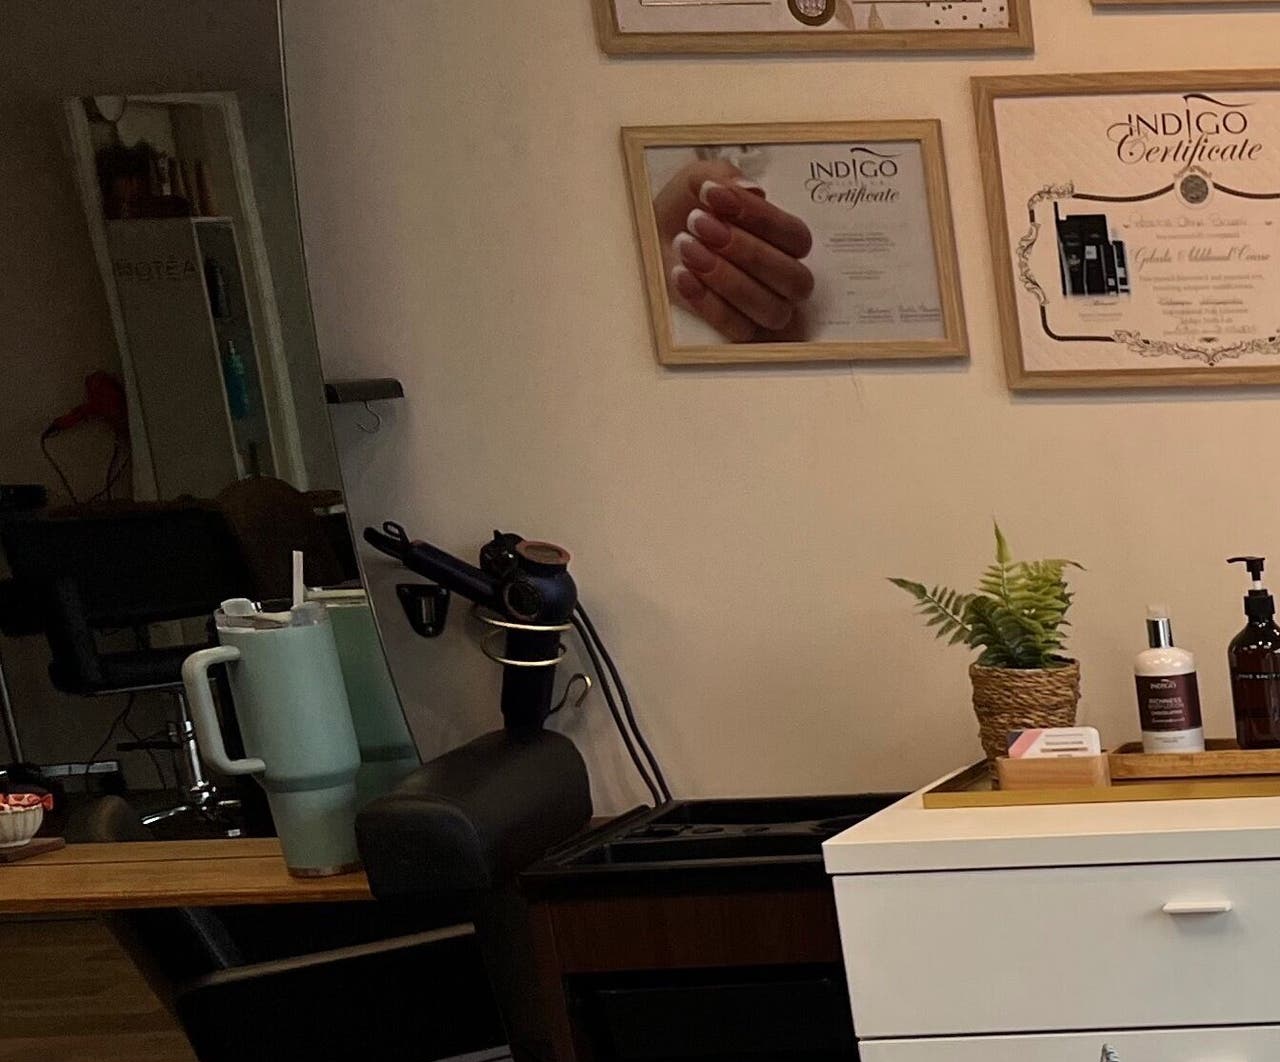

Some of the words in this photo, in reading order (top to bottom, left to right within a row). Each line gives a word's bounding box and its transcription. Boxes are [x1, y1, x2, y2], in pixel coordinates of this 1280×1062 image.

[1128, 109, 1247, 138] INDIGO
[1107, 123, 1262, 167] Certificate
[810, 158, 898, 181] INDIGO
[804, 178, 899, 208] Certificate
